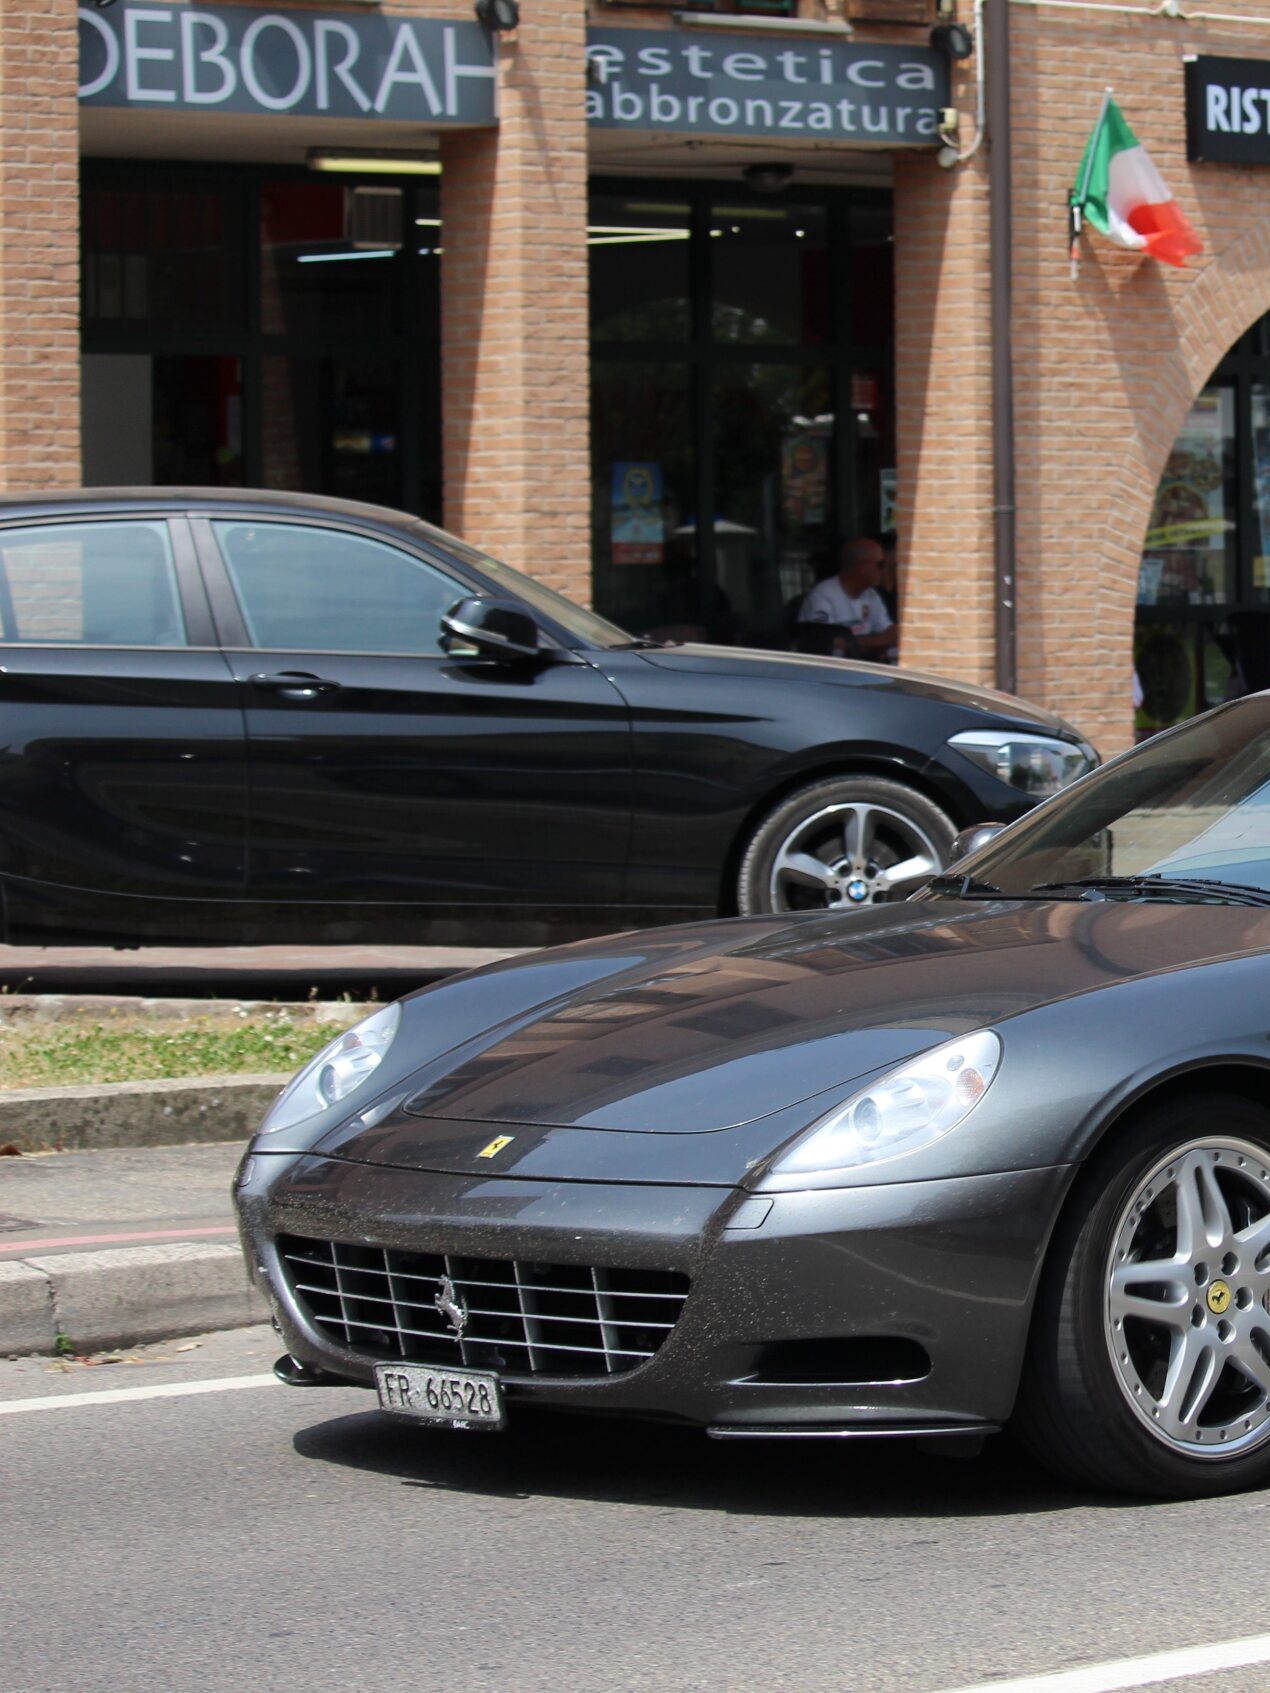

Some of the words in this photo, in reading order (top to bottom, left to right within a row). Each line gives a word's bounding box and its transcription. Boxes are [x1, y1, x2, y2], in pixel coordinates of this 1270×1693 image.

[585, 43, 935, 90] estetica
[585, 82, 938, 135] abbronzatura
[384, 1372, 413, 1407] FR
[426, 1377, 492, 1415] 66528
